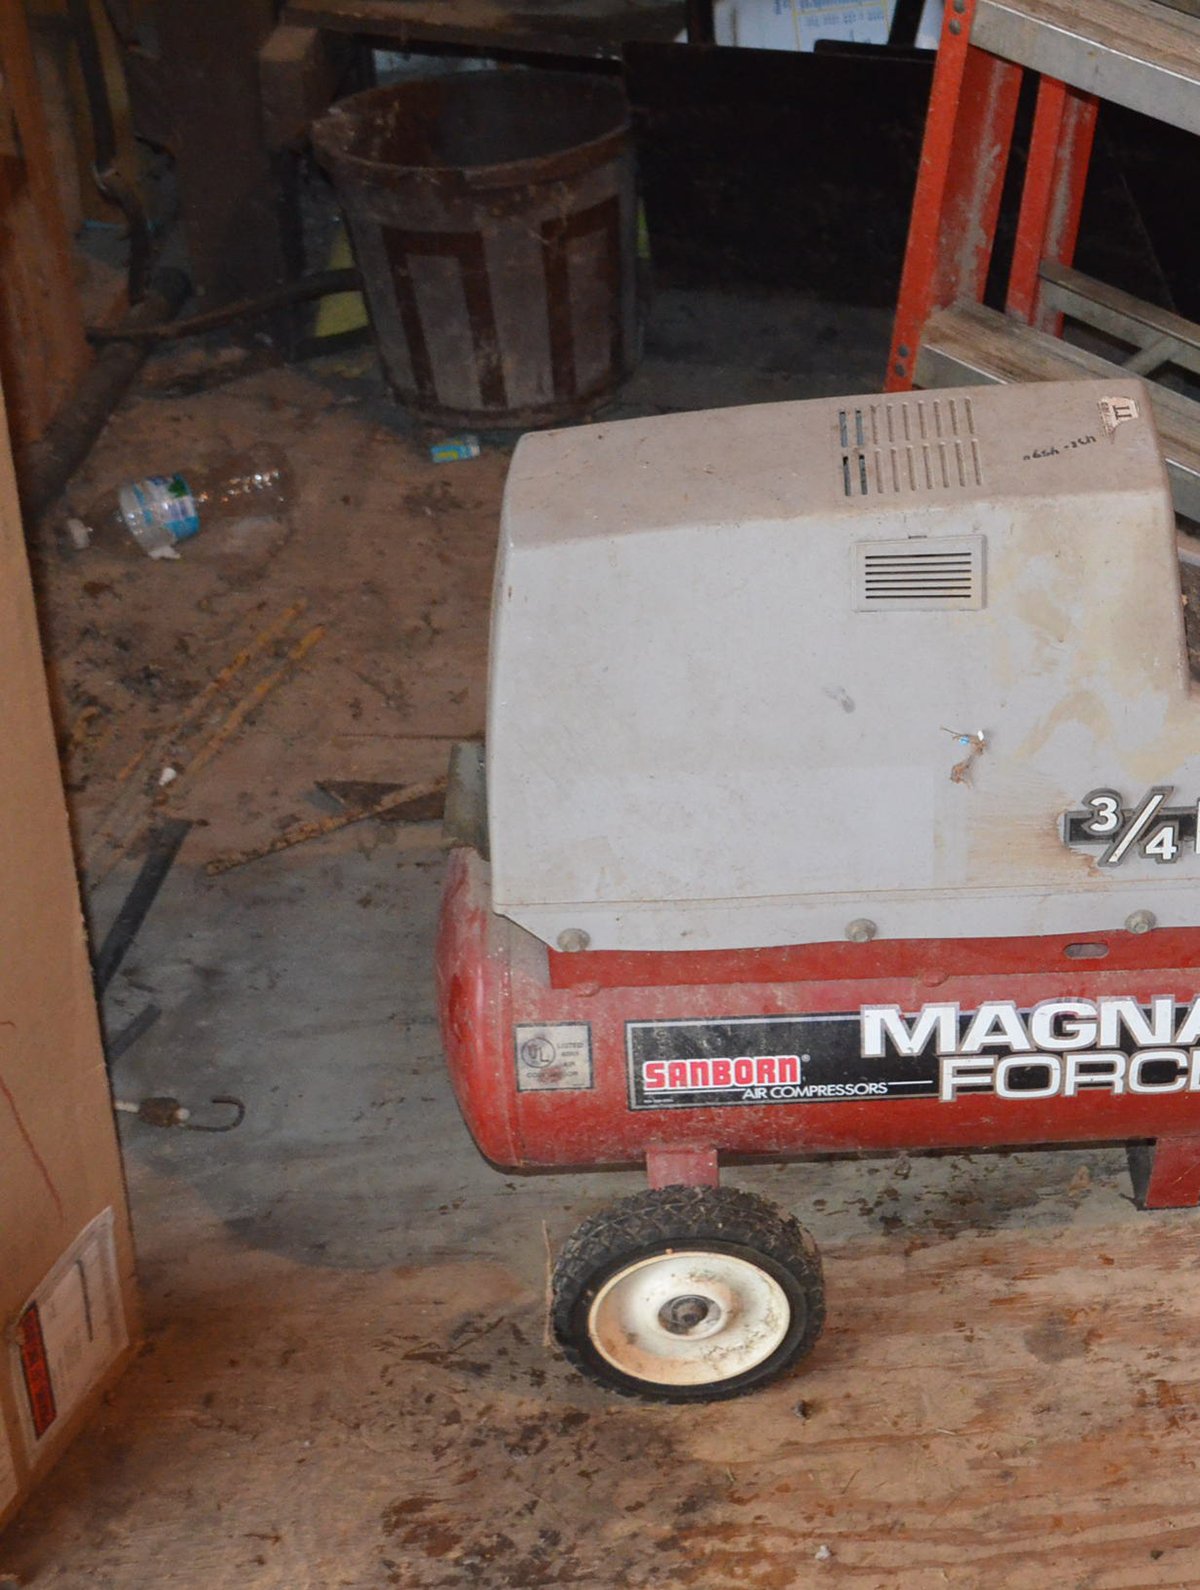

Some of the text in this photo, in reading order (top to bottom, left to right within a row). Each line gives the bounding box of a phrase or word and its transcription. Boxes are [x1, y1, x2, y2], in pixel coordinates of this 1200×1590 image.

[1086, 789, 1180, 865] 3/4
[644, 1056, 801, 1091] SANBORN
[742, 1081, 889, 1100] AIR COMPRESSORS
